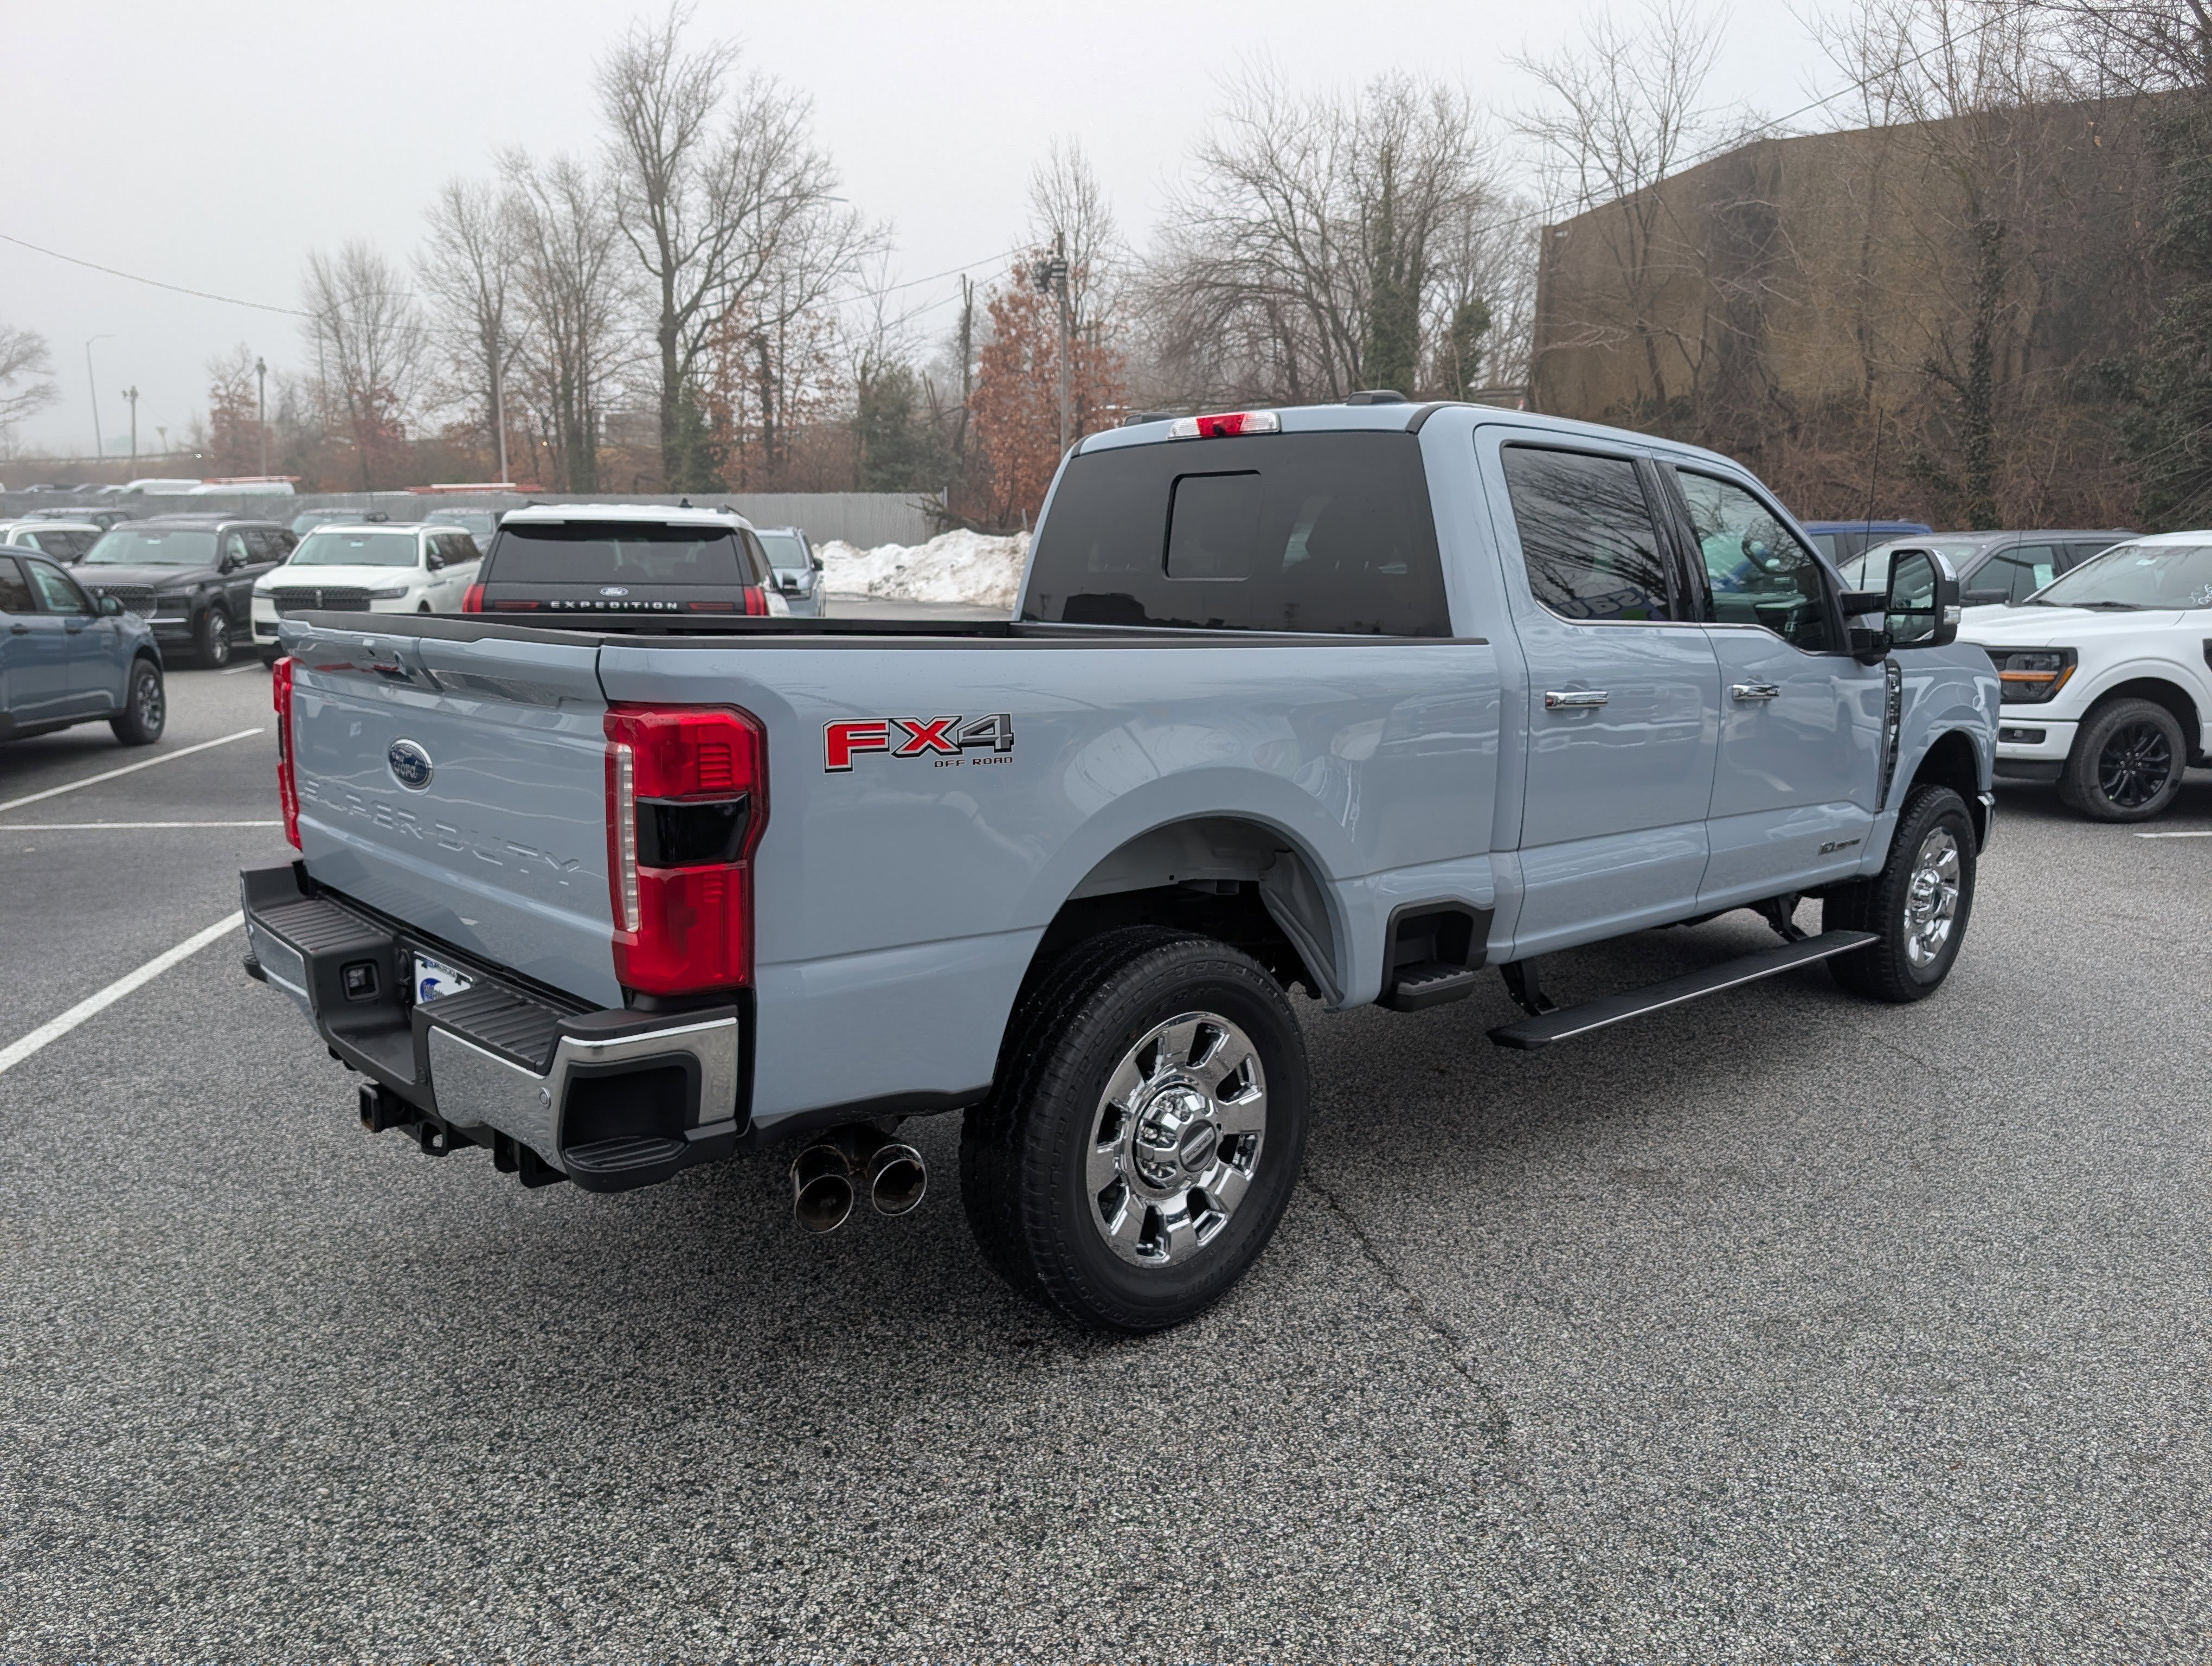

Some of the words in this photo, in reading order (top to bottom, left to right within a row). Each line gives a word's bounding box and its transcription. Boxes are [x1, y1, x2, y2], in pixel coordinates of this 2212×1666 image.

[550, 600, 678, 609] EXPEDITION
[821, 712, 1015, 774] FX4
[934, 760, 966, 768] OFF
[972, 757, 1013, 766] ROAD
[435, 819, 580, 886] DUTY
[1186, 1134, 1212, 1159] FORD
